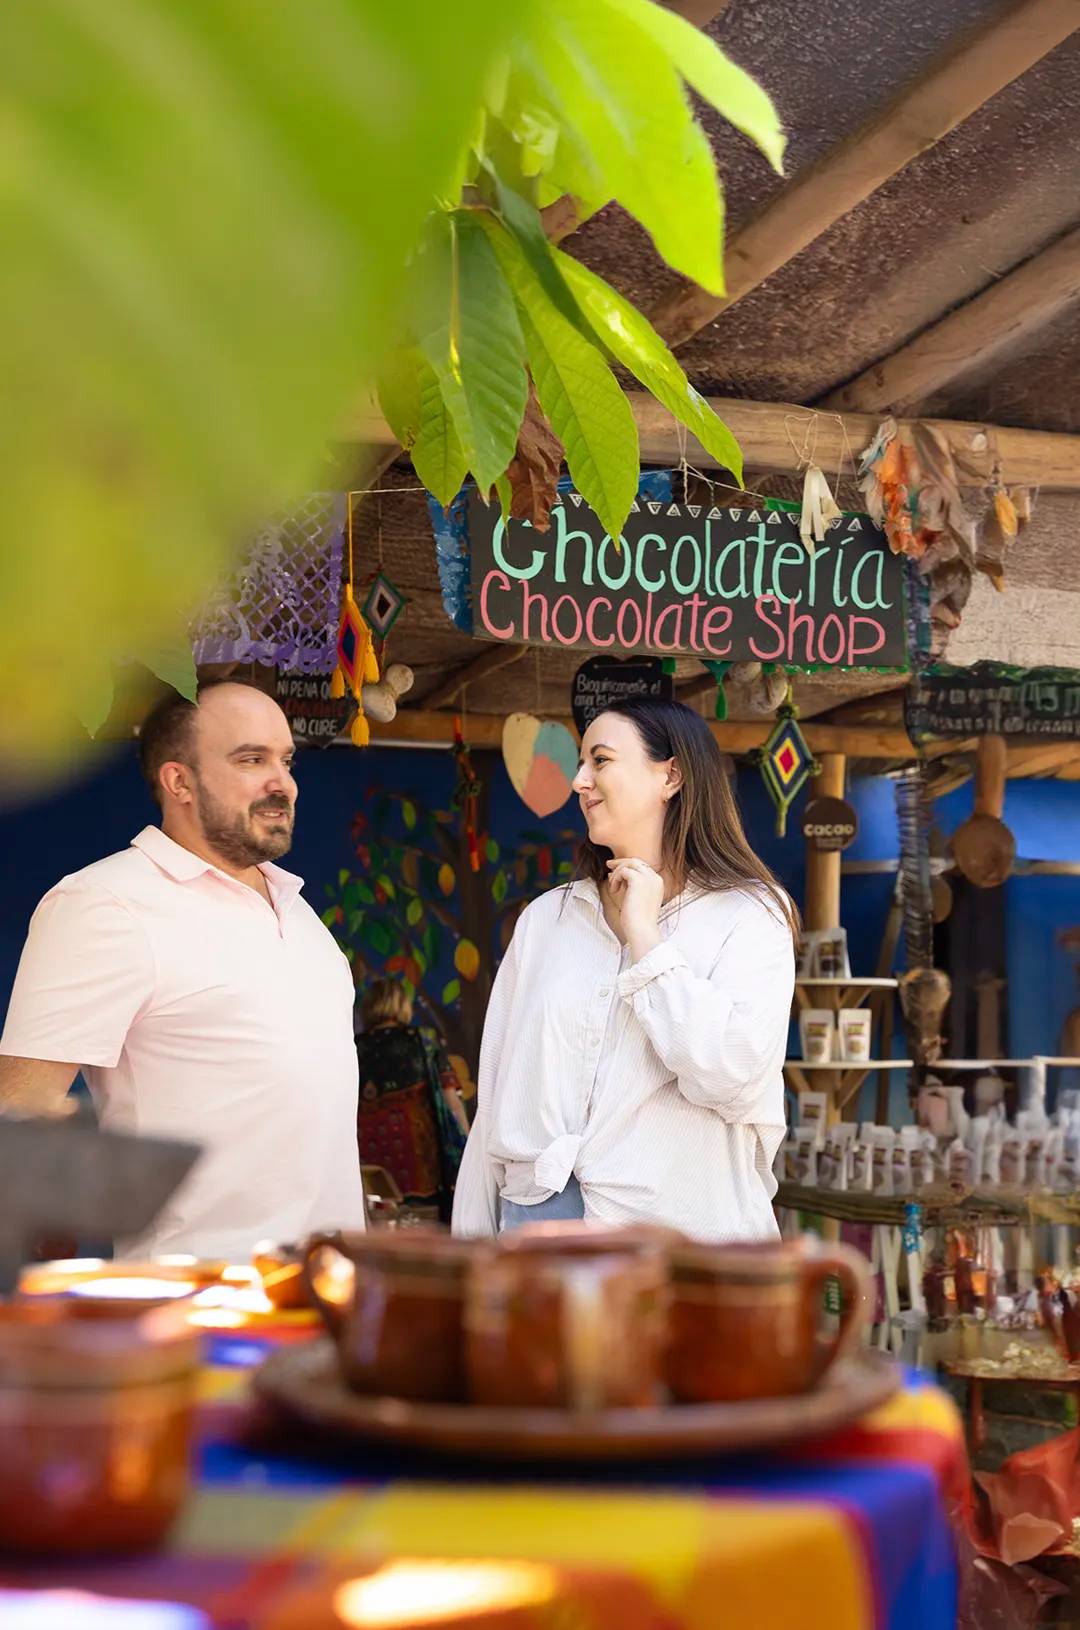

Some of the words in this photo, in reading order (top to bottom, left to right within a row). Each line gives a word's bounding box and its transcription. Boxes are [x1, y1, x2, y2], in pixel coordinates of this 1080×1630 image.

[492, 506, 893, 609] Chocolatería
[480, 569, 732, 656] Chocolate
[276, 681, 289, 695] NI
[290, 681, 318, 698] PENA
[292, 717, 307, 734] NO
[308, 718, 337, 736] CURE
